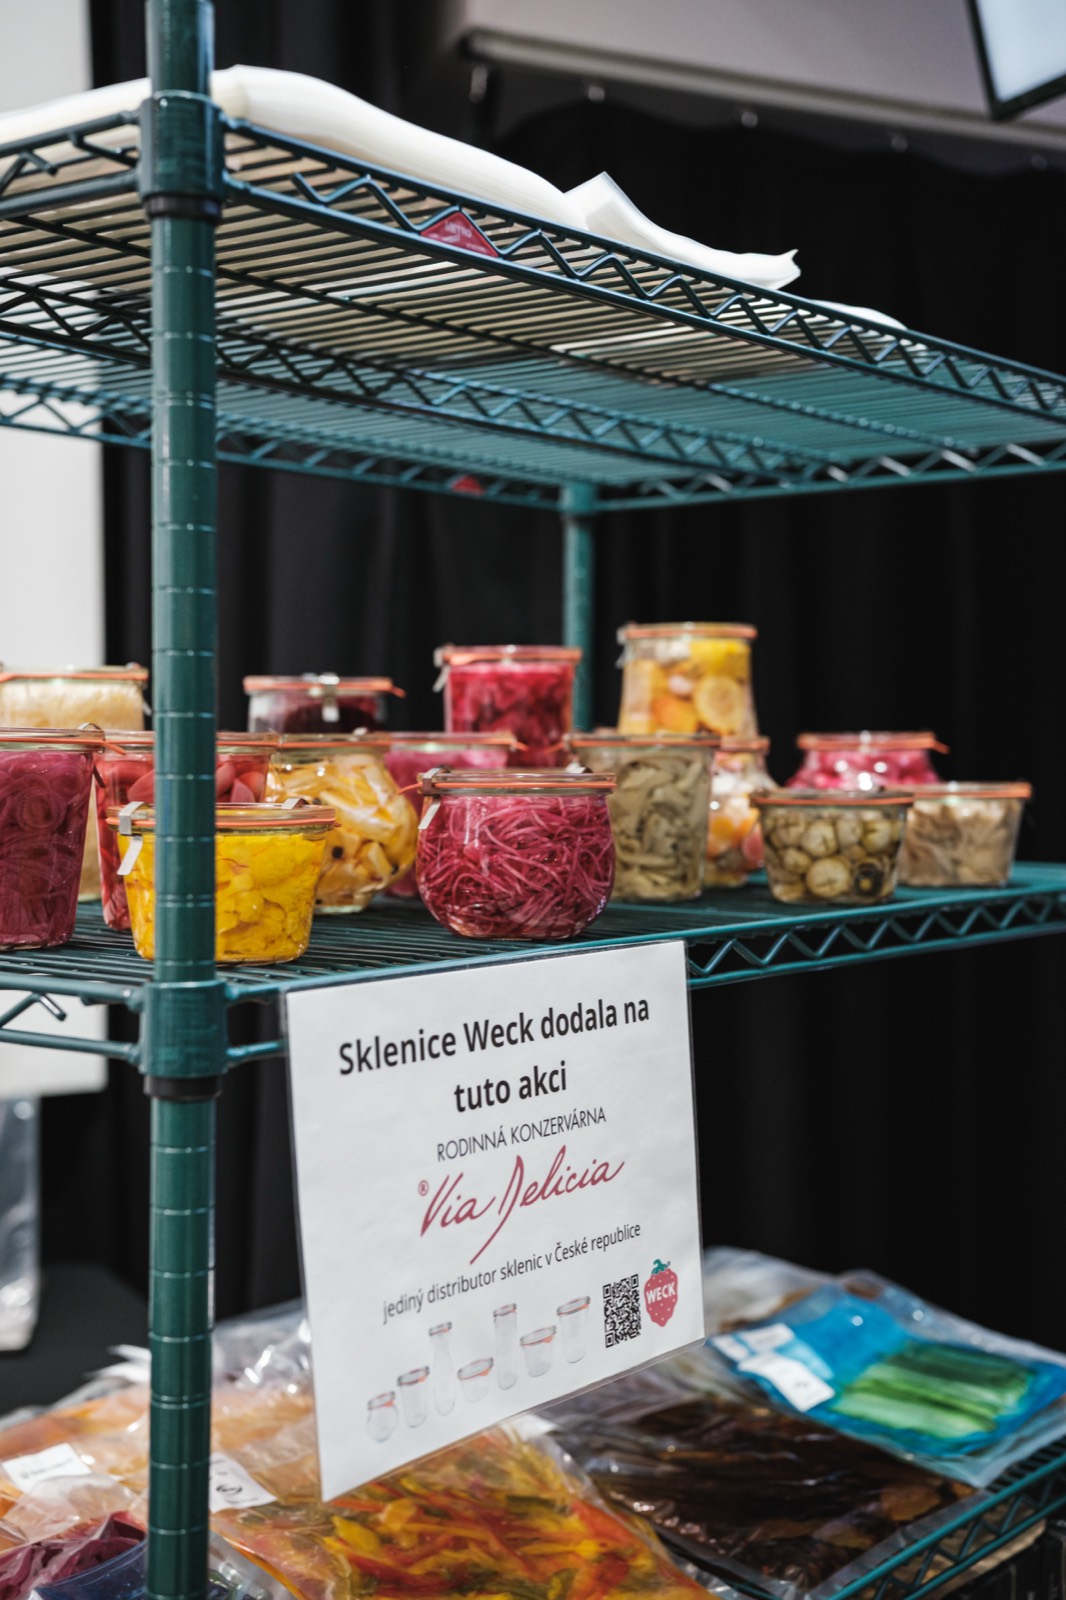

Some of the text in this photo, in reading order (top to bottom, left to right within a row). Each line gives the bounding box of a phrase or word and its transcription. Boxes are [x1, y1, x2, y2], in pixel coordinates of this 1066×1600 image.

[339, 998, 649, 1075] Sklenice Weck dodala na
[454, 1060, 566, 1113] tuto akci
[437, 1106, 607, 1162] RODINNÁ KONZERVÁRNA
[420, 1144, 625, 1265] Via Delicia
[383, 1223, 641, 1325] jediný distributor sklenic v České republice
[645, 1281, 676, 1305] WECK
